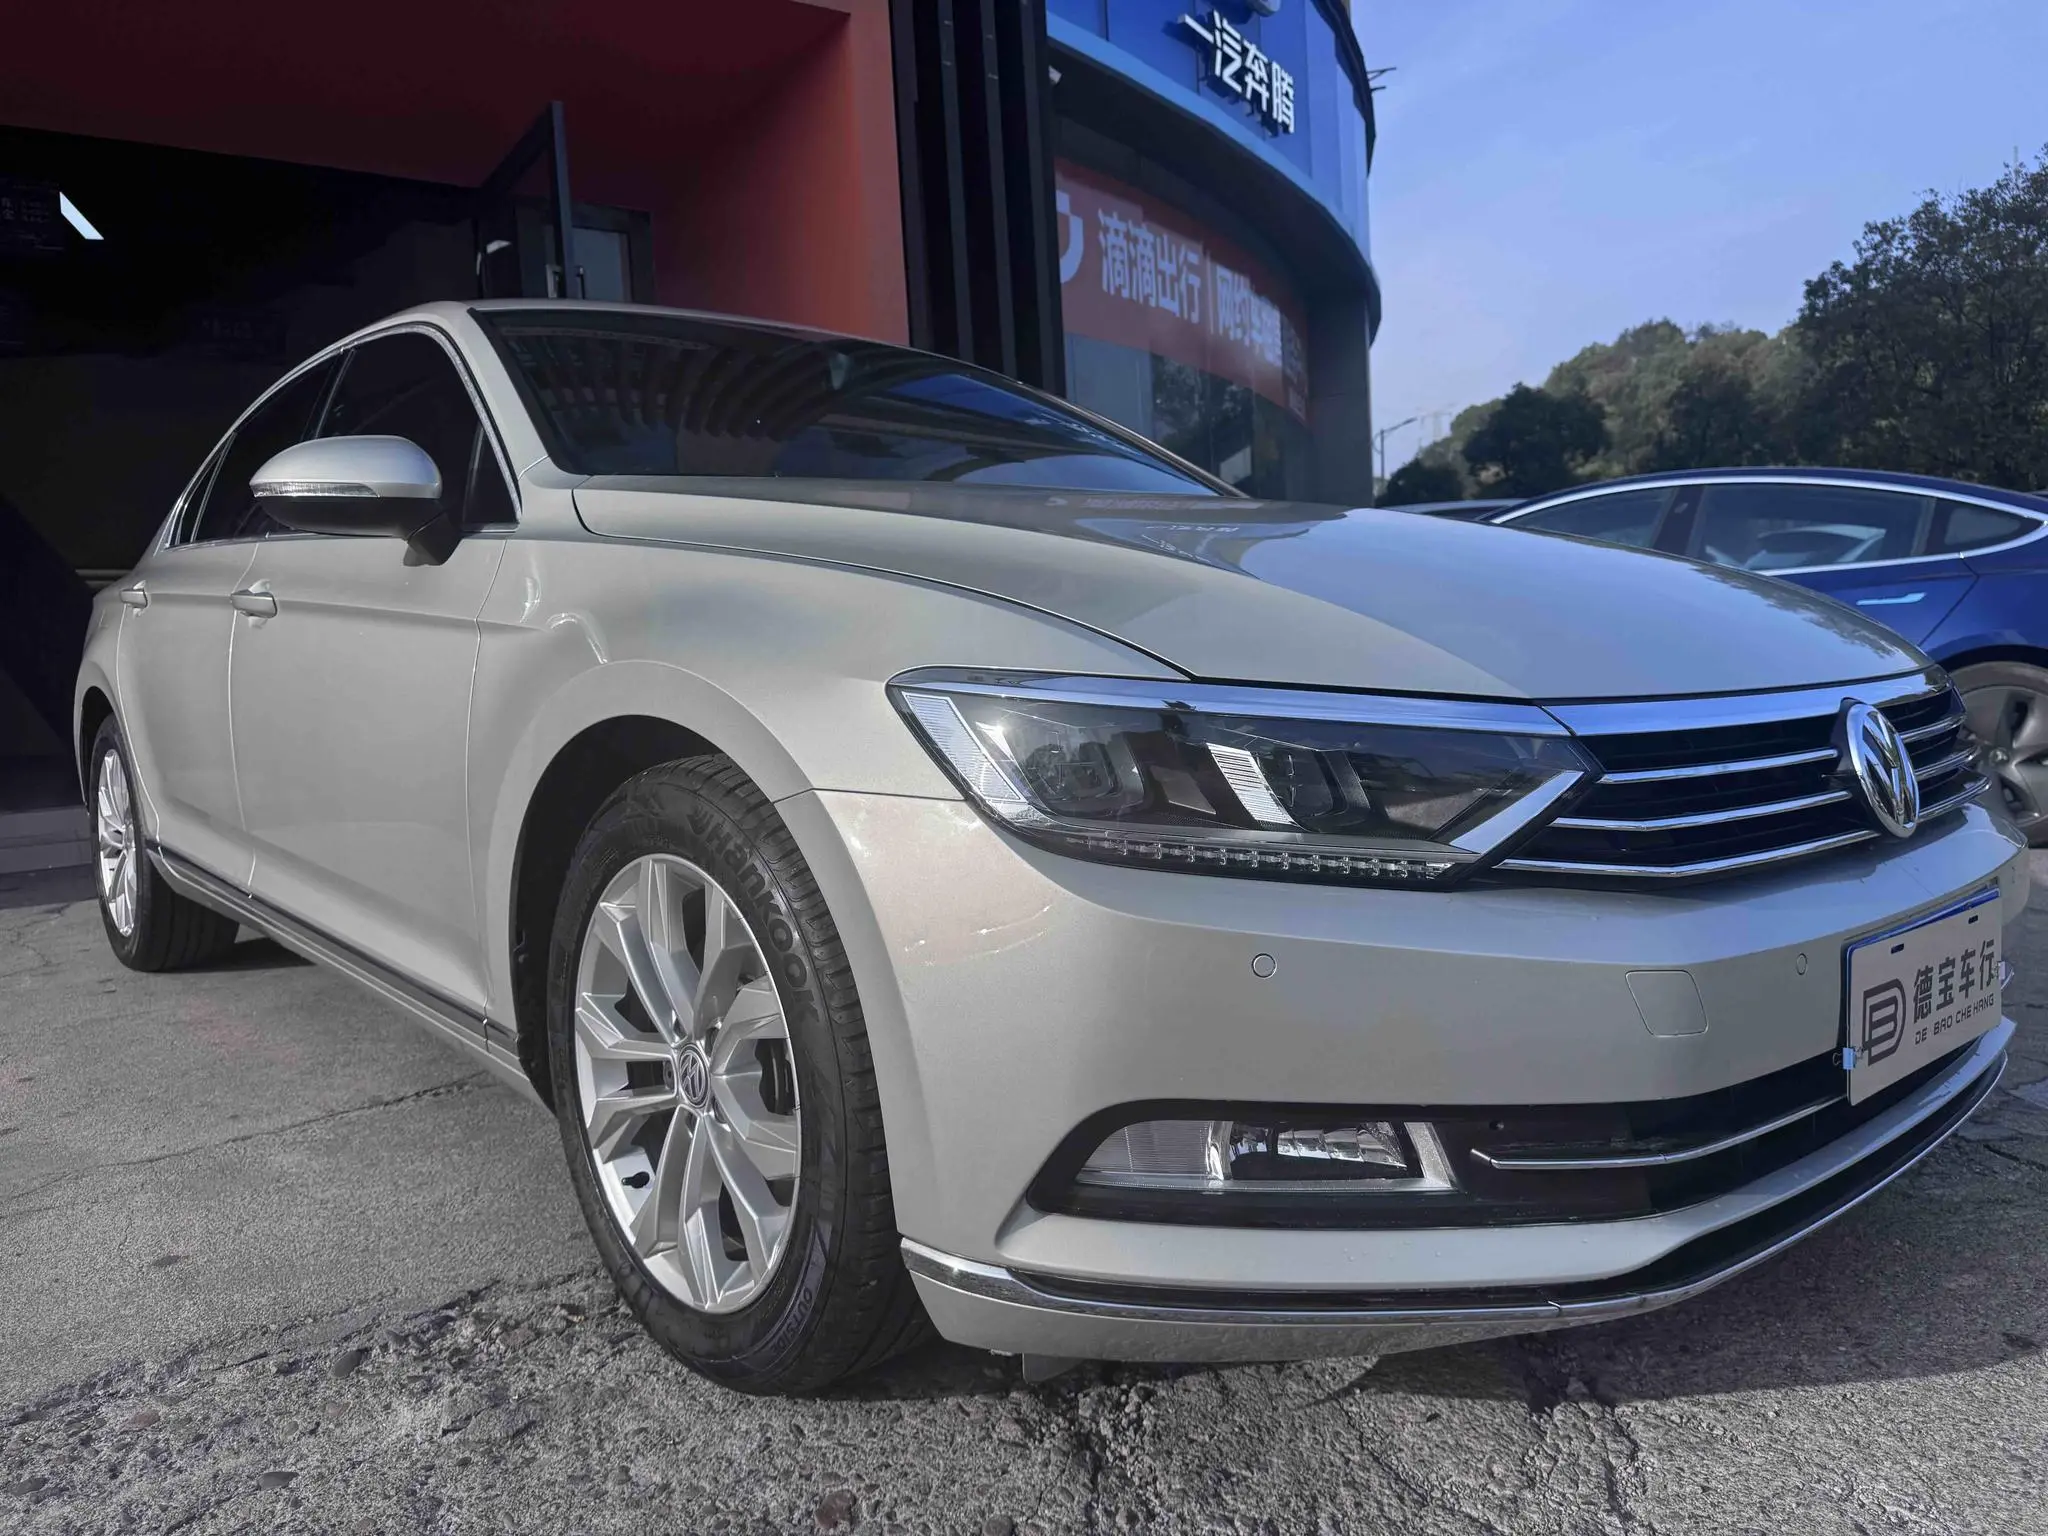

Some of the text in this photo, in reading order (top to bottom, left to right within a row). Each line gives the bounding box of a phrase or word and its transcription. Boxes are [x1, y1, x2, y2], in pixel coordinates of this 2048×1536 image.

[1178, 9, 1295, 134] 一汽奔腾
[1098, 208, 1202, 324] 滴滴出行
[1913, 939, 1995, 1024] 德宝车行
[1915, 993, 1995, 1045] DE BAO CHE HANG
[772, 1286, 814, 1357] OUTSIDE
